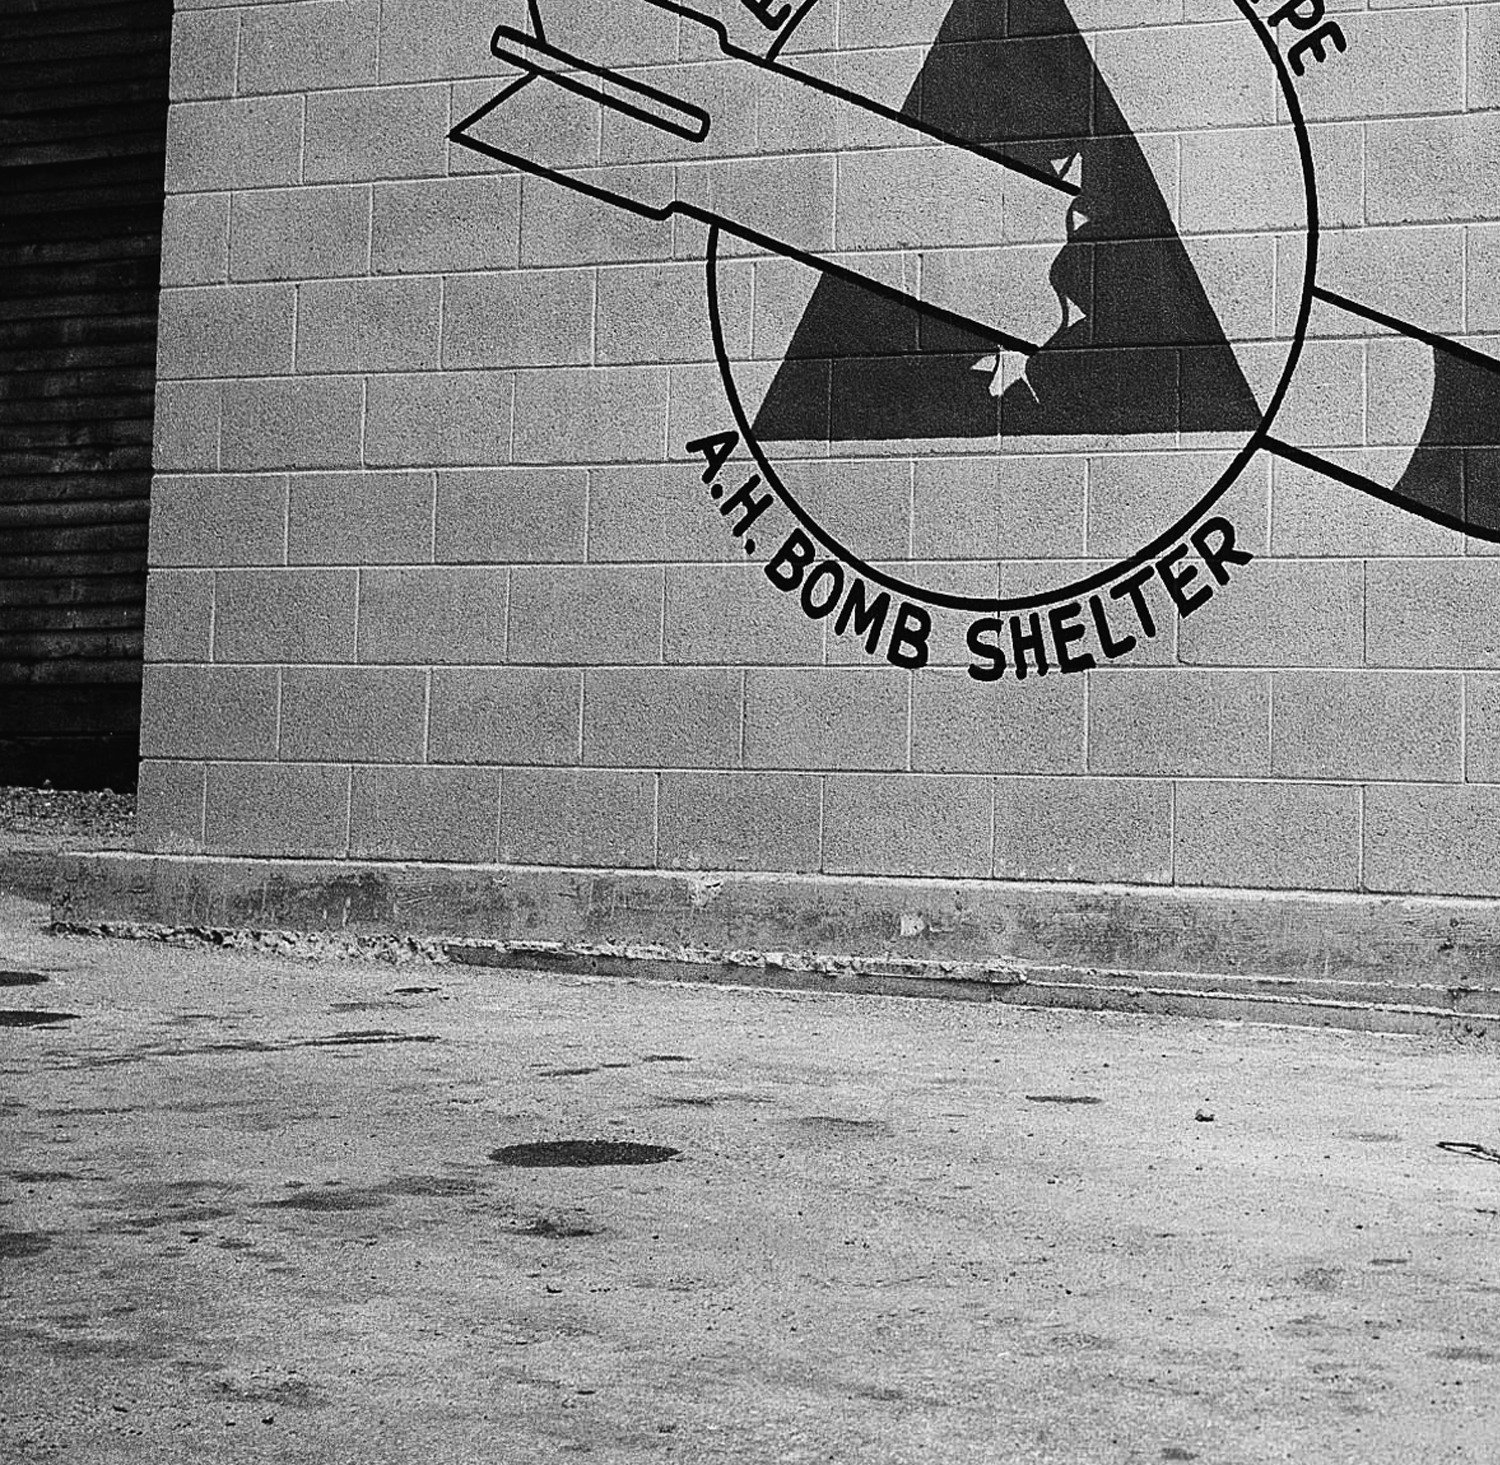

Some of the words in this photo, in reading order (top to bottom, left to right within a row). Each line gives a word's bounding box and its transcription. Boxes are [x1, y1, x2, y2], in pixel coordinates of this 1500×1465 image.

[686, 429, 774, 555] A.H.
[765, 528, 934, 670] BOMB
[967, 515, 1254, 682] SHELTER
